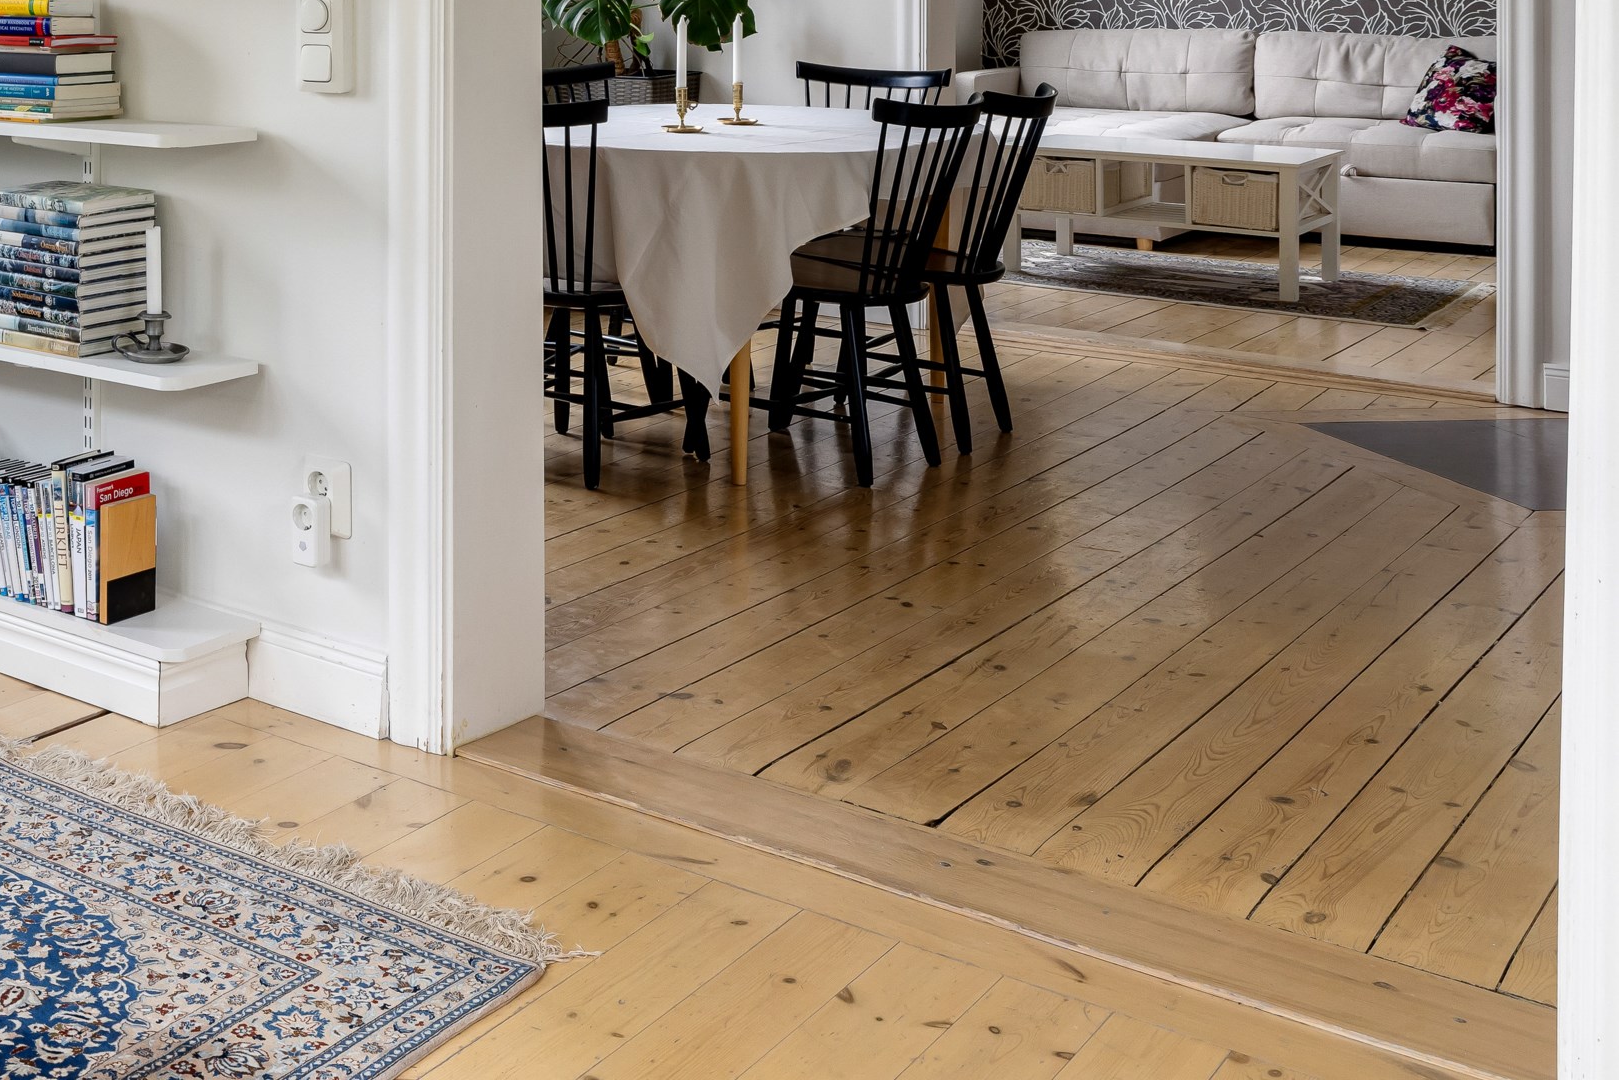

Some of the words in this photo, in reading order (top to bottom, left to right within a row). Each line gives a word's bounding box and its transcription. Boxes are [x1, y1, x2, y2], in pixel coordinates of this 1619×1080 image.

[99, 492, 113, 503] San
[113, 486, 134, 500] Diego
[75, 528, 83, 554] JAPAN
